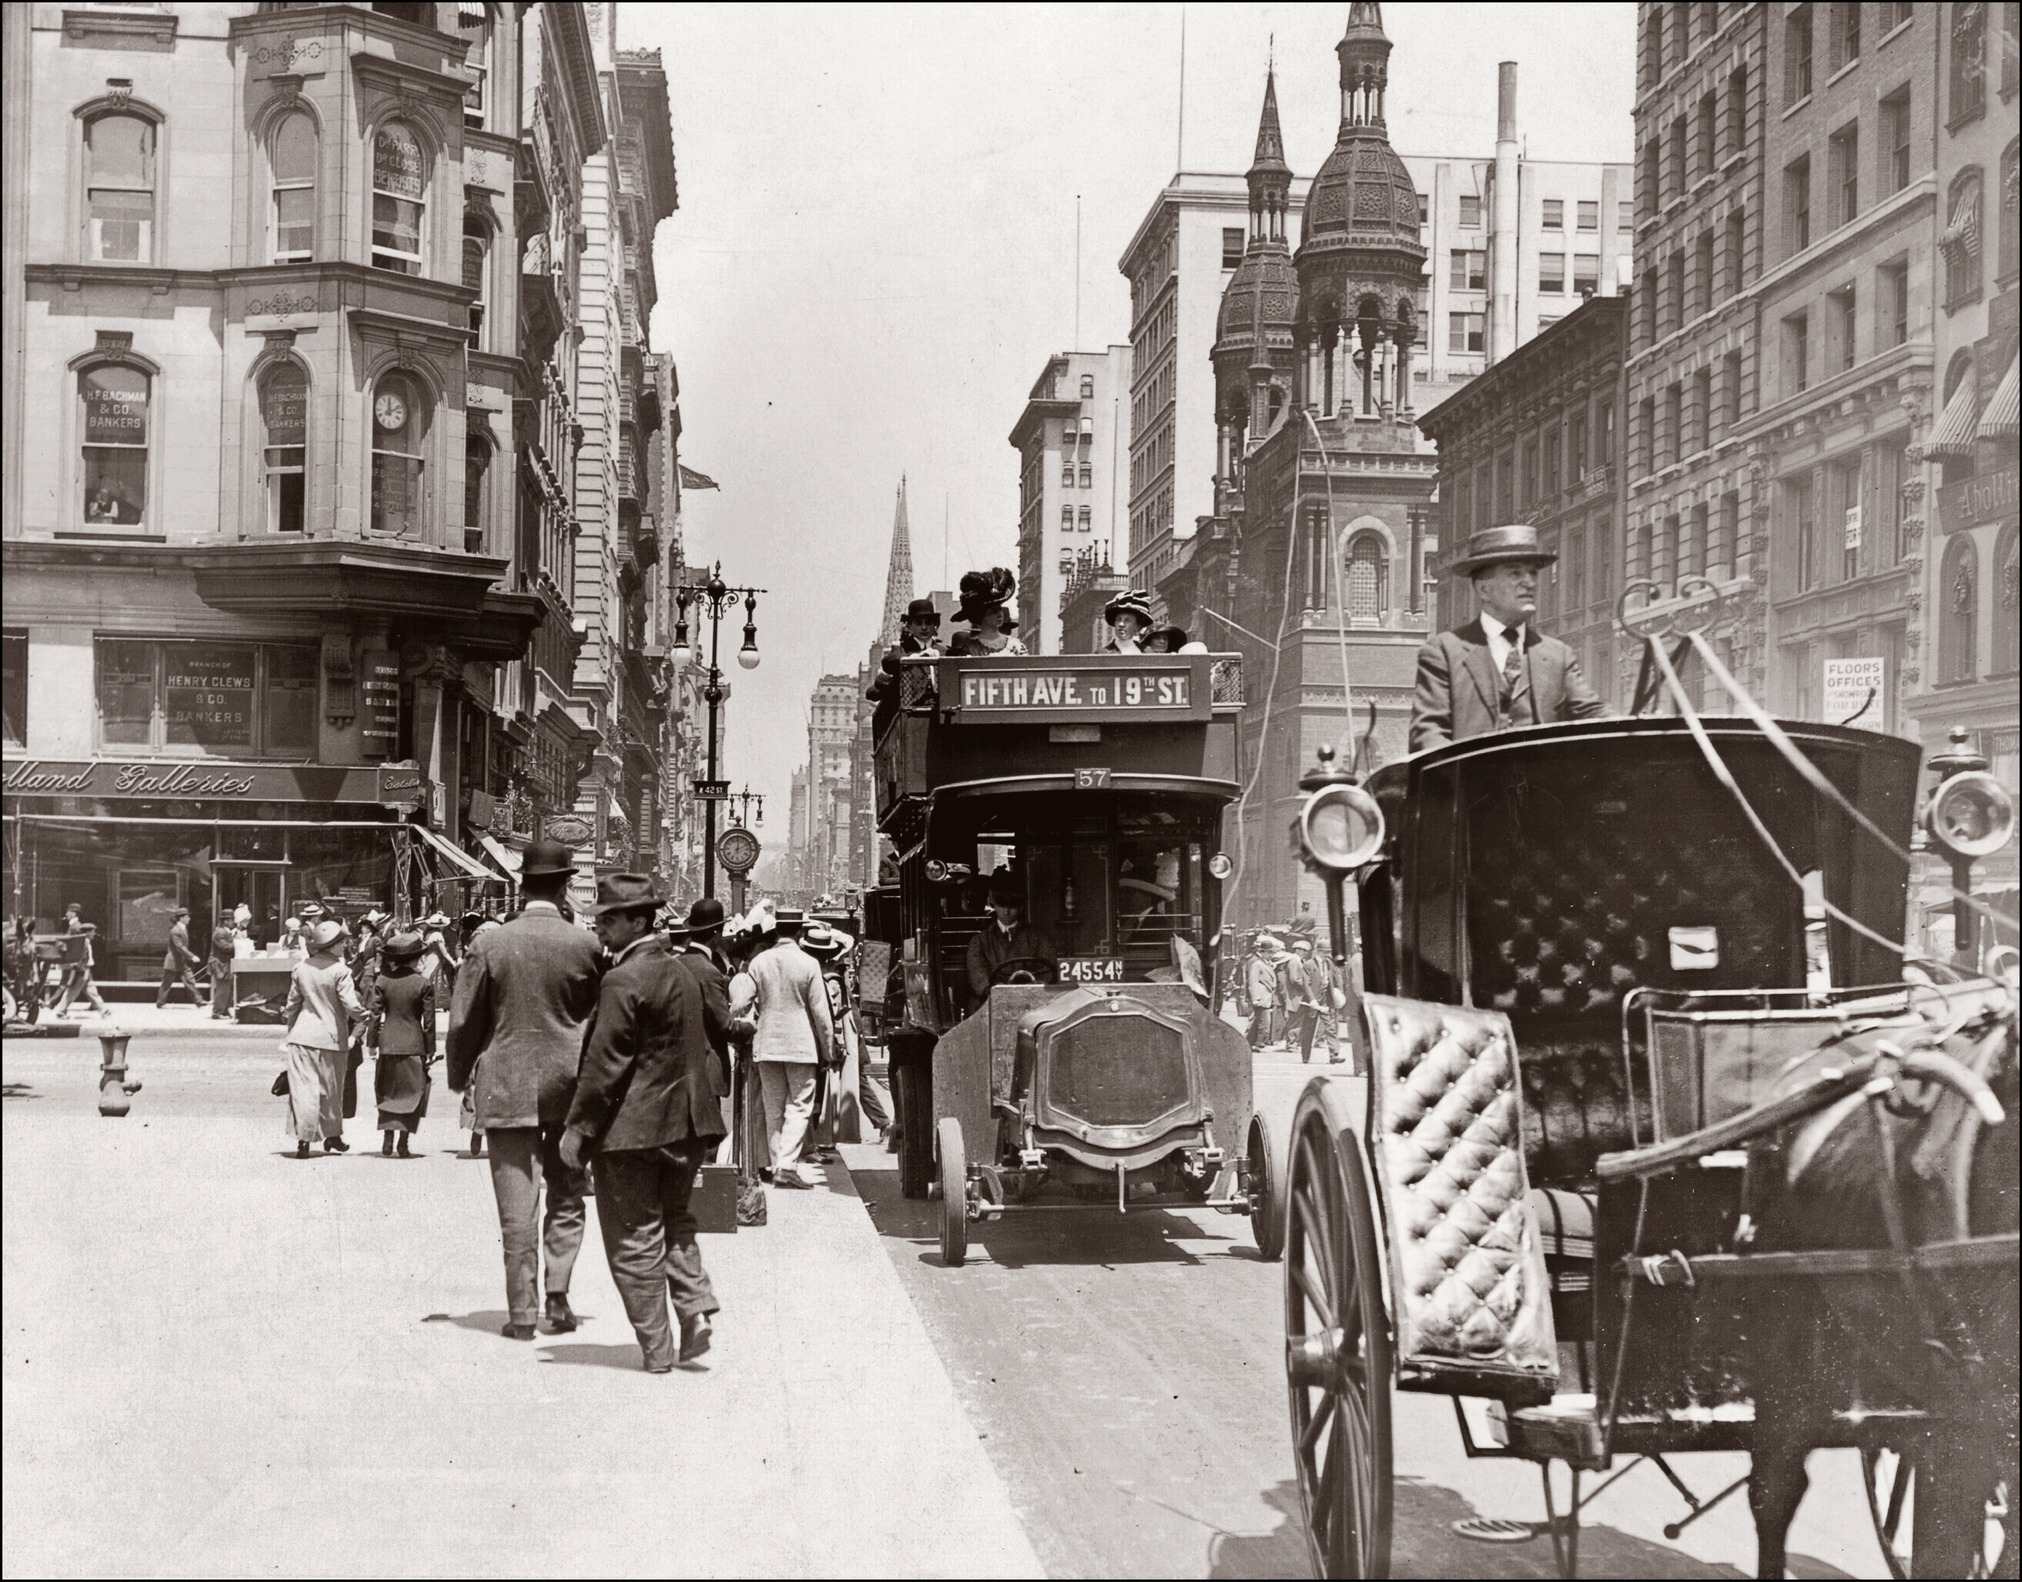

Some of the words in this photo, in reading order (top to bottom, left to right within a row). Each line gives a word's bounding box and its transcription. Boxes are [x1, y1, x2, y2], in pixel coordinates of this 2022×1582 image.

[389, 155, 420, 173] CLOSE
[375, 168, 420, 194] DENTISTS
[100, 403, 109, 415] &
[112, 404, 132, 416] CO.
[89, 416, 141, 429] BANKERS
[189, 660, 220, 669] BRANCH
[1827, 662, 1880, 675] FLOORS
[168, 675, 208, 687] HENRY
[211, 676, 251, 688] CLEWS
[1827, 675, 1881, 688] OFFICES
[964, 677, 1028, 706] FIFTH
[1032, 677, 1083, 706] AVE.
[1089, 687, 1107, 705] TO
[1157, 677, 1188, 705] ST.
[207, 694, 228, 705] CO.
[176, 711, 242, 723] BANKERS
[114, 764, 257, 795] Galleries
[1079, 770, 1108, 788] 57
[705, 786, 715, 794] 42
[1059, 960, 1115, 982] 24554
